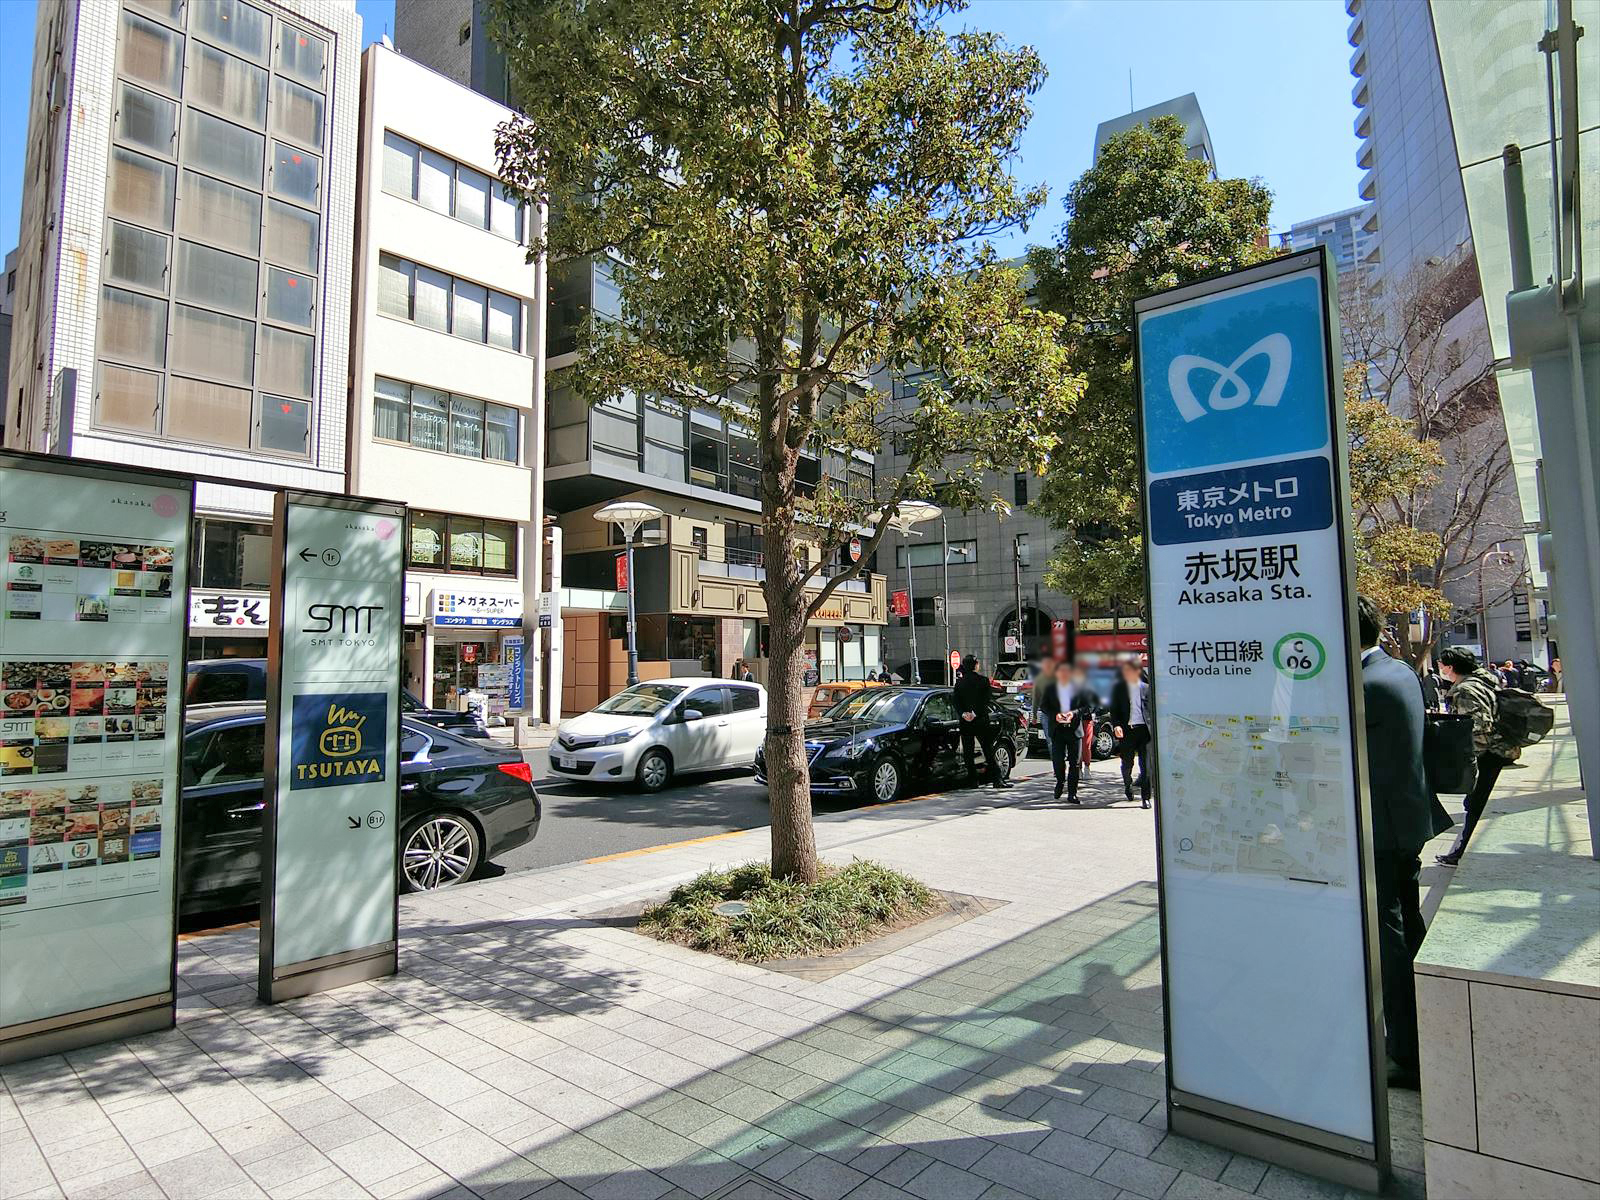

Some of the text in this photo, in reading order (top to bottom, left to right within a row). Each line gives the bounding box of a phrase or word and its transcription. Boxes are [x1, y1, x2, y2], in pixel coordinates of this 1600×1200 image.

[1176, 477, 1299, 512] 東京メトロ
[111, 497, 152, 508] akasaka
[1185, 505, 1292, 529] Tokyo Metro
[344, 523, 375, 532] akasaka
[327, 552, 336, 562] 1F
[1184, 544, 1301, 586] 赤坂駅
[457, 596, 520, 608] メガネスーパー
[1178, 584, 1312, 606] Akasaka Sta.
[302, 603, 384, 634] SMT
[311, 638, 375, 647] SMT TOKYO
[1293, 639, 1304, 653] C
[1167, 640, 1264, 663] 千代田線
[1286, 655, 1312, 670] 06
[1168, 664, 1252, 678] Chiyoda Line
[297, 758, 381, 780] TSUTAYA
[368, 815, 384, 827] B1F
